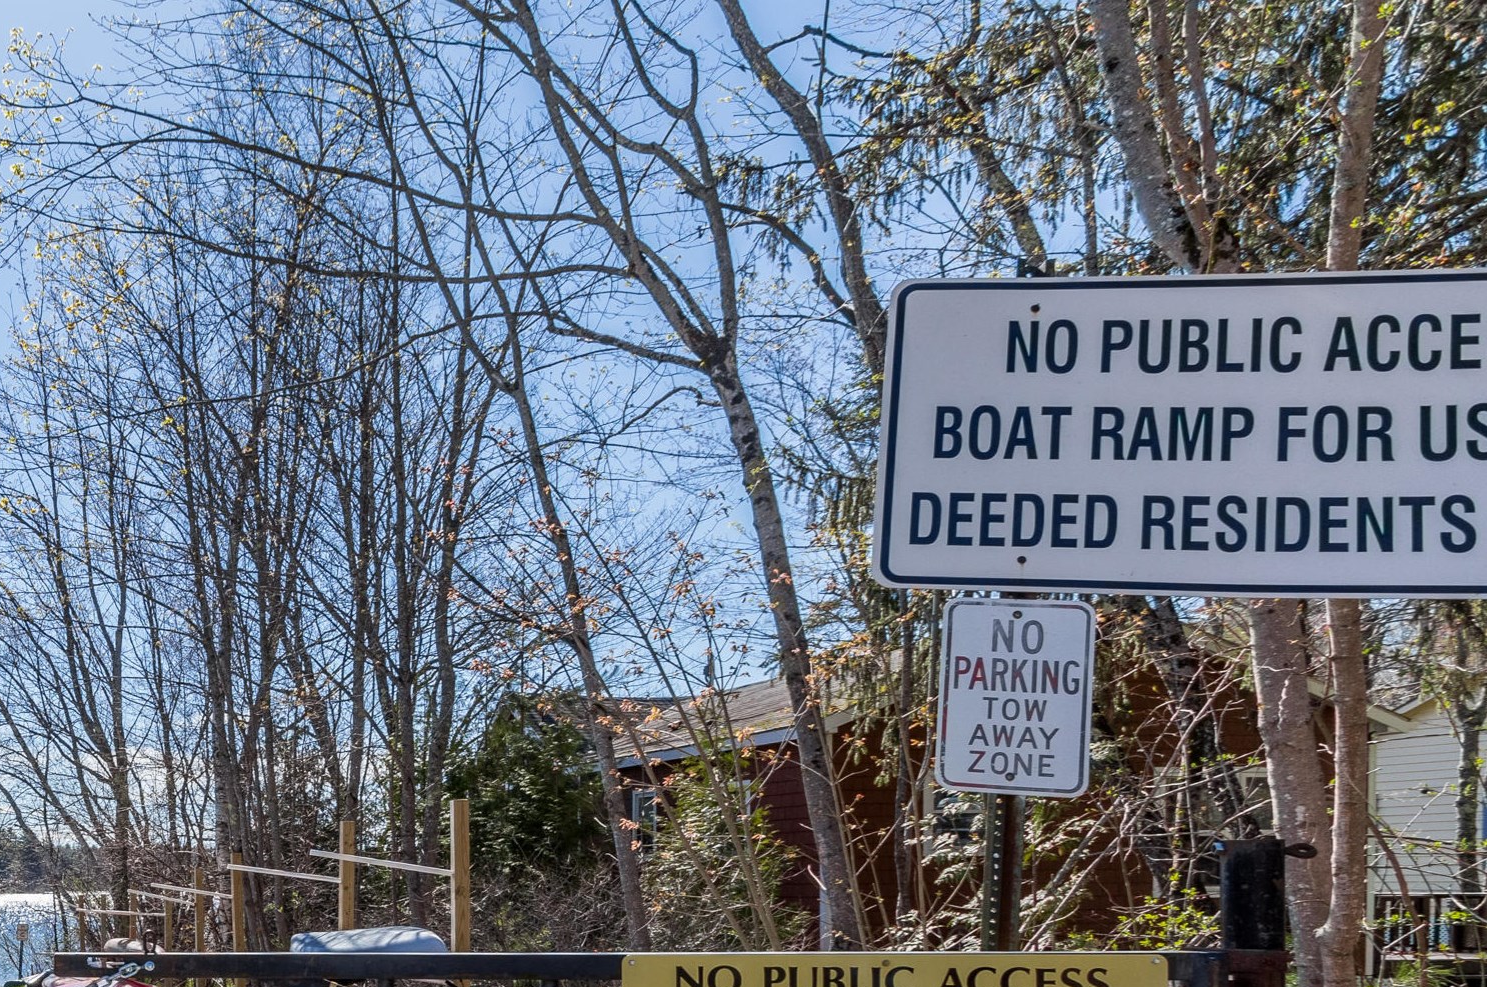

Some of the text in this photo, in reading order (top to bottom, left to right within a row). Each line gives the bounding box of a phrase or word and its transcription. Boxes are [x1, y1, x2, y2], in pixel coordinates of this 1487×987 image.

[1006, 313, 1482, 374] NO PUBLIC ACCE
[933, 402, 1487, 463] BOAT RAMP FOR US
[909, 491, 1477, 554] DEEDED RESIDENTS
[991, 618, 1045, 655] NO
[953, 655, 1081, 696] PARKING
[983, 696, 1048, 723] TOW
[967, 723, 1060, 750] AWAY
[967, 750, 1056, 778] ZONE
